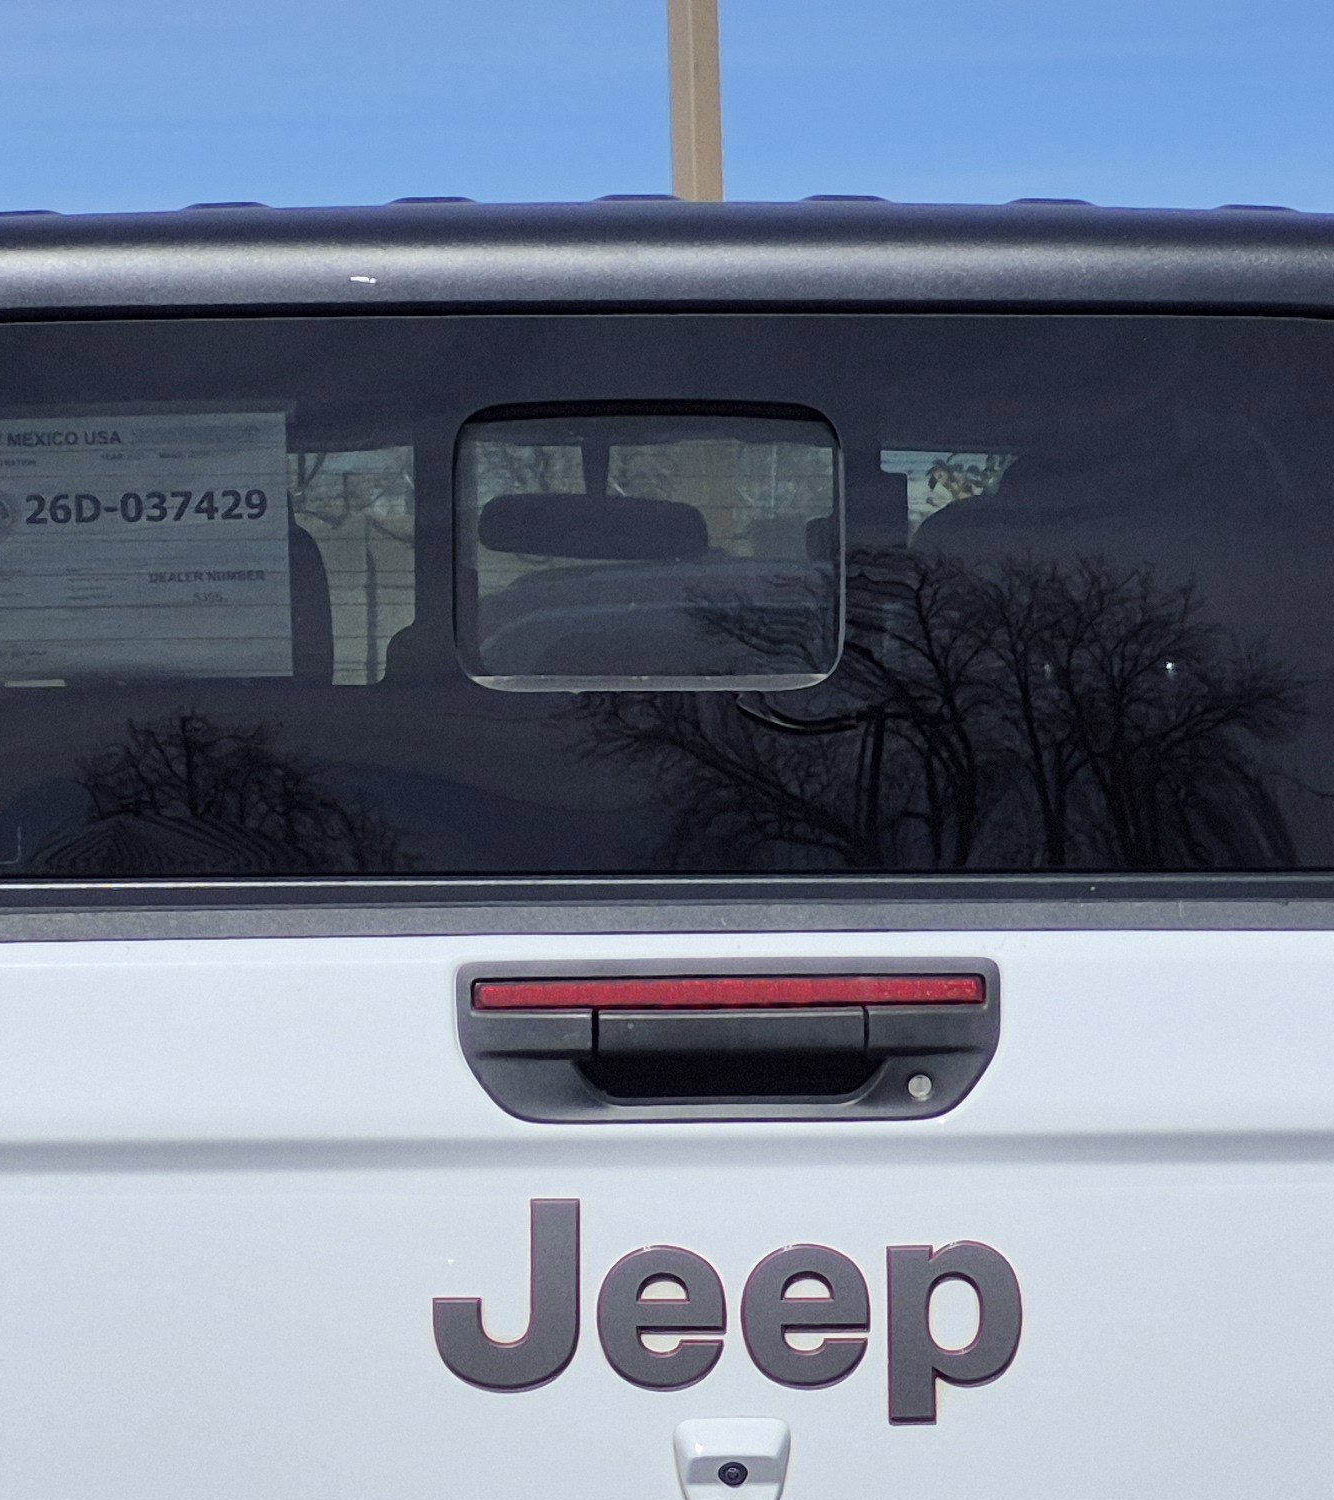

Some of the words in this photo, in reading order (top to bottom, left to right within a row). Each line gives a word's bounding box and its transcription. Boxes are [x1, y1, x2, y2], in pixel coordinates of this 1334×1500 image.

[7, 431, 78, 447] MEXICO
[83, 430, 122, 445] USA
[25, 488, 267, 525] 26D-037429
[148, 571, 204, 584] DEALER
[206, 569, 265, 582] NUMBER
[432, 1198, 1022, 1425] Jeep
